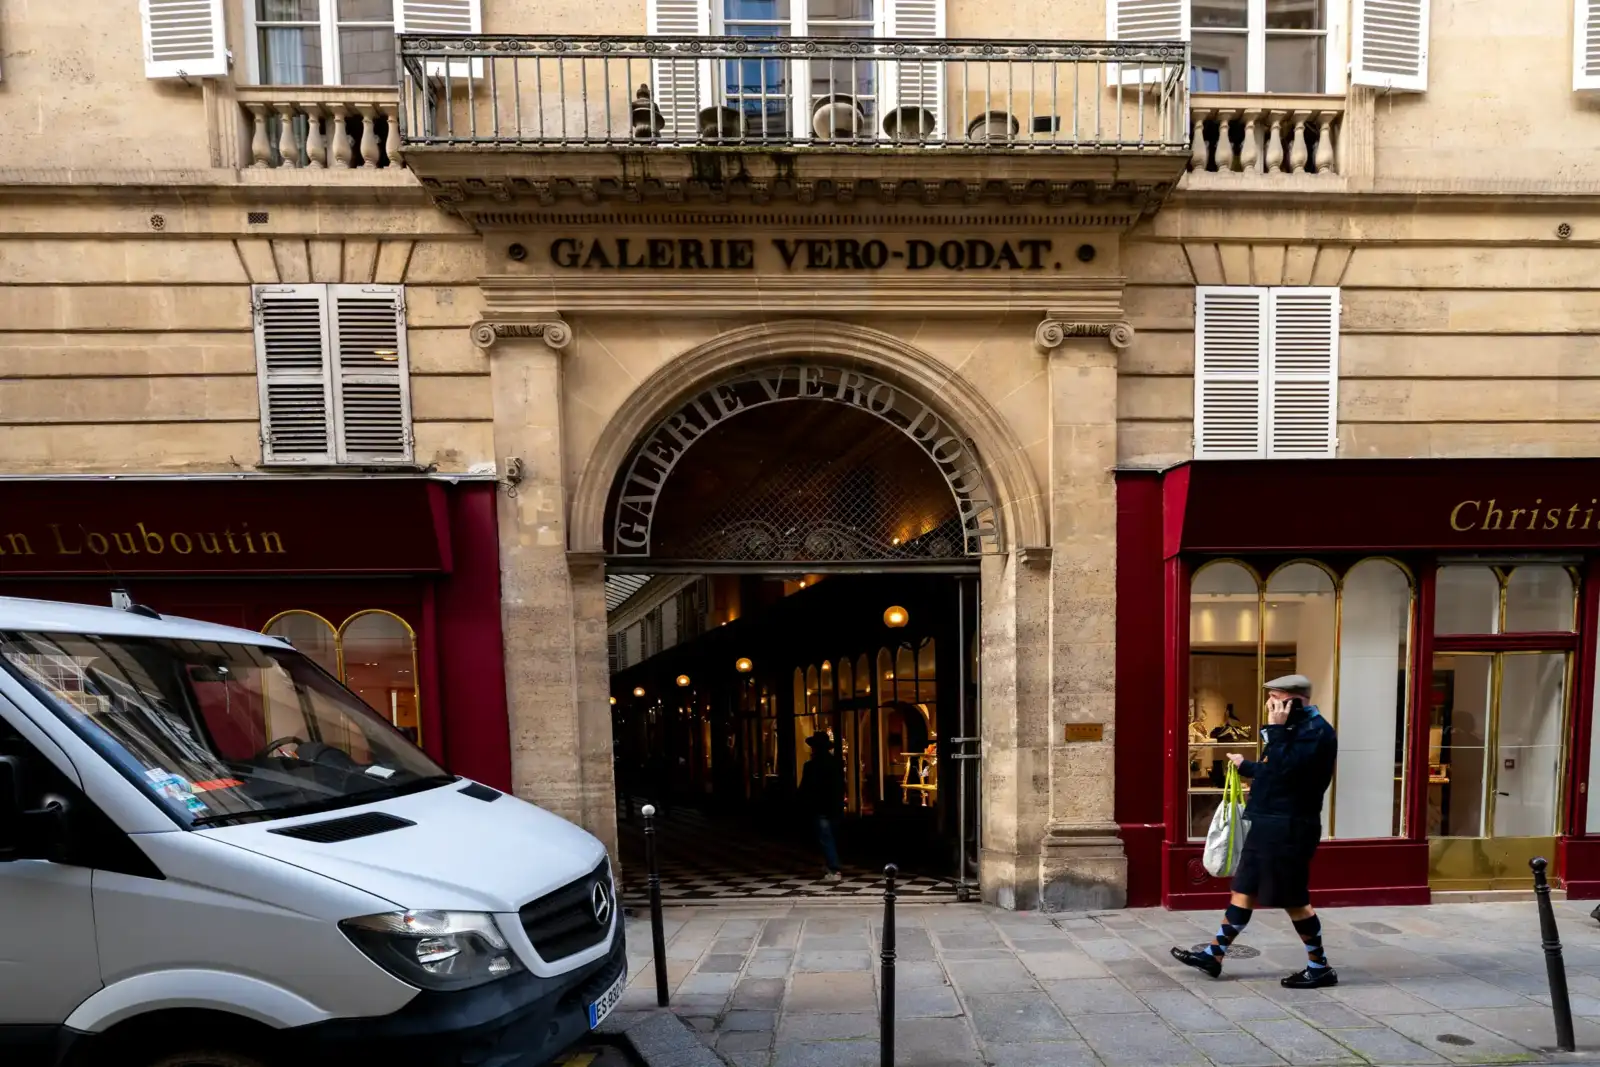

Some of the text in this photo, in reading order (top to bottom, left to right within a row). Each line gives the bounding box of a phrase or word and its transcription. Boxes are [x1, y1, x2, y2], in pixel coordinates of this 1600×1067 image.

[550, 238, 754, 270] GALERIE
[616, 365, 999, 548] GALERIE VERO DODAT
[1450, 498, 1600, 531] Christi
[47, 522, 286, 555] Louboutin
